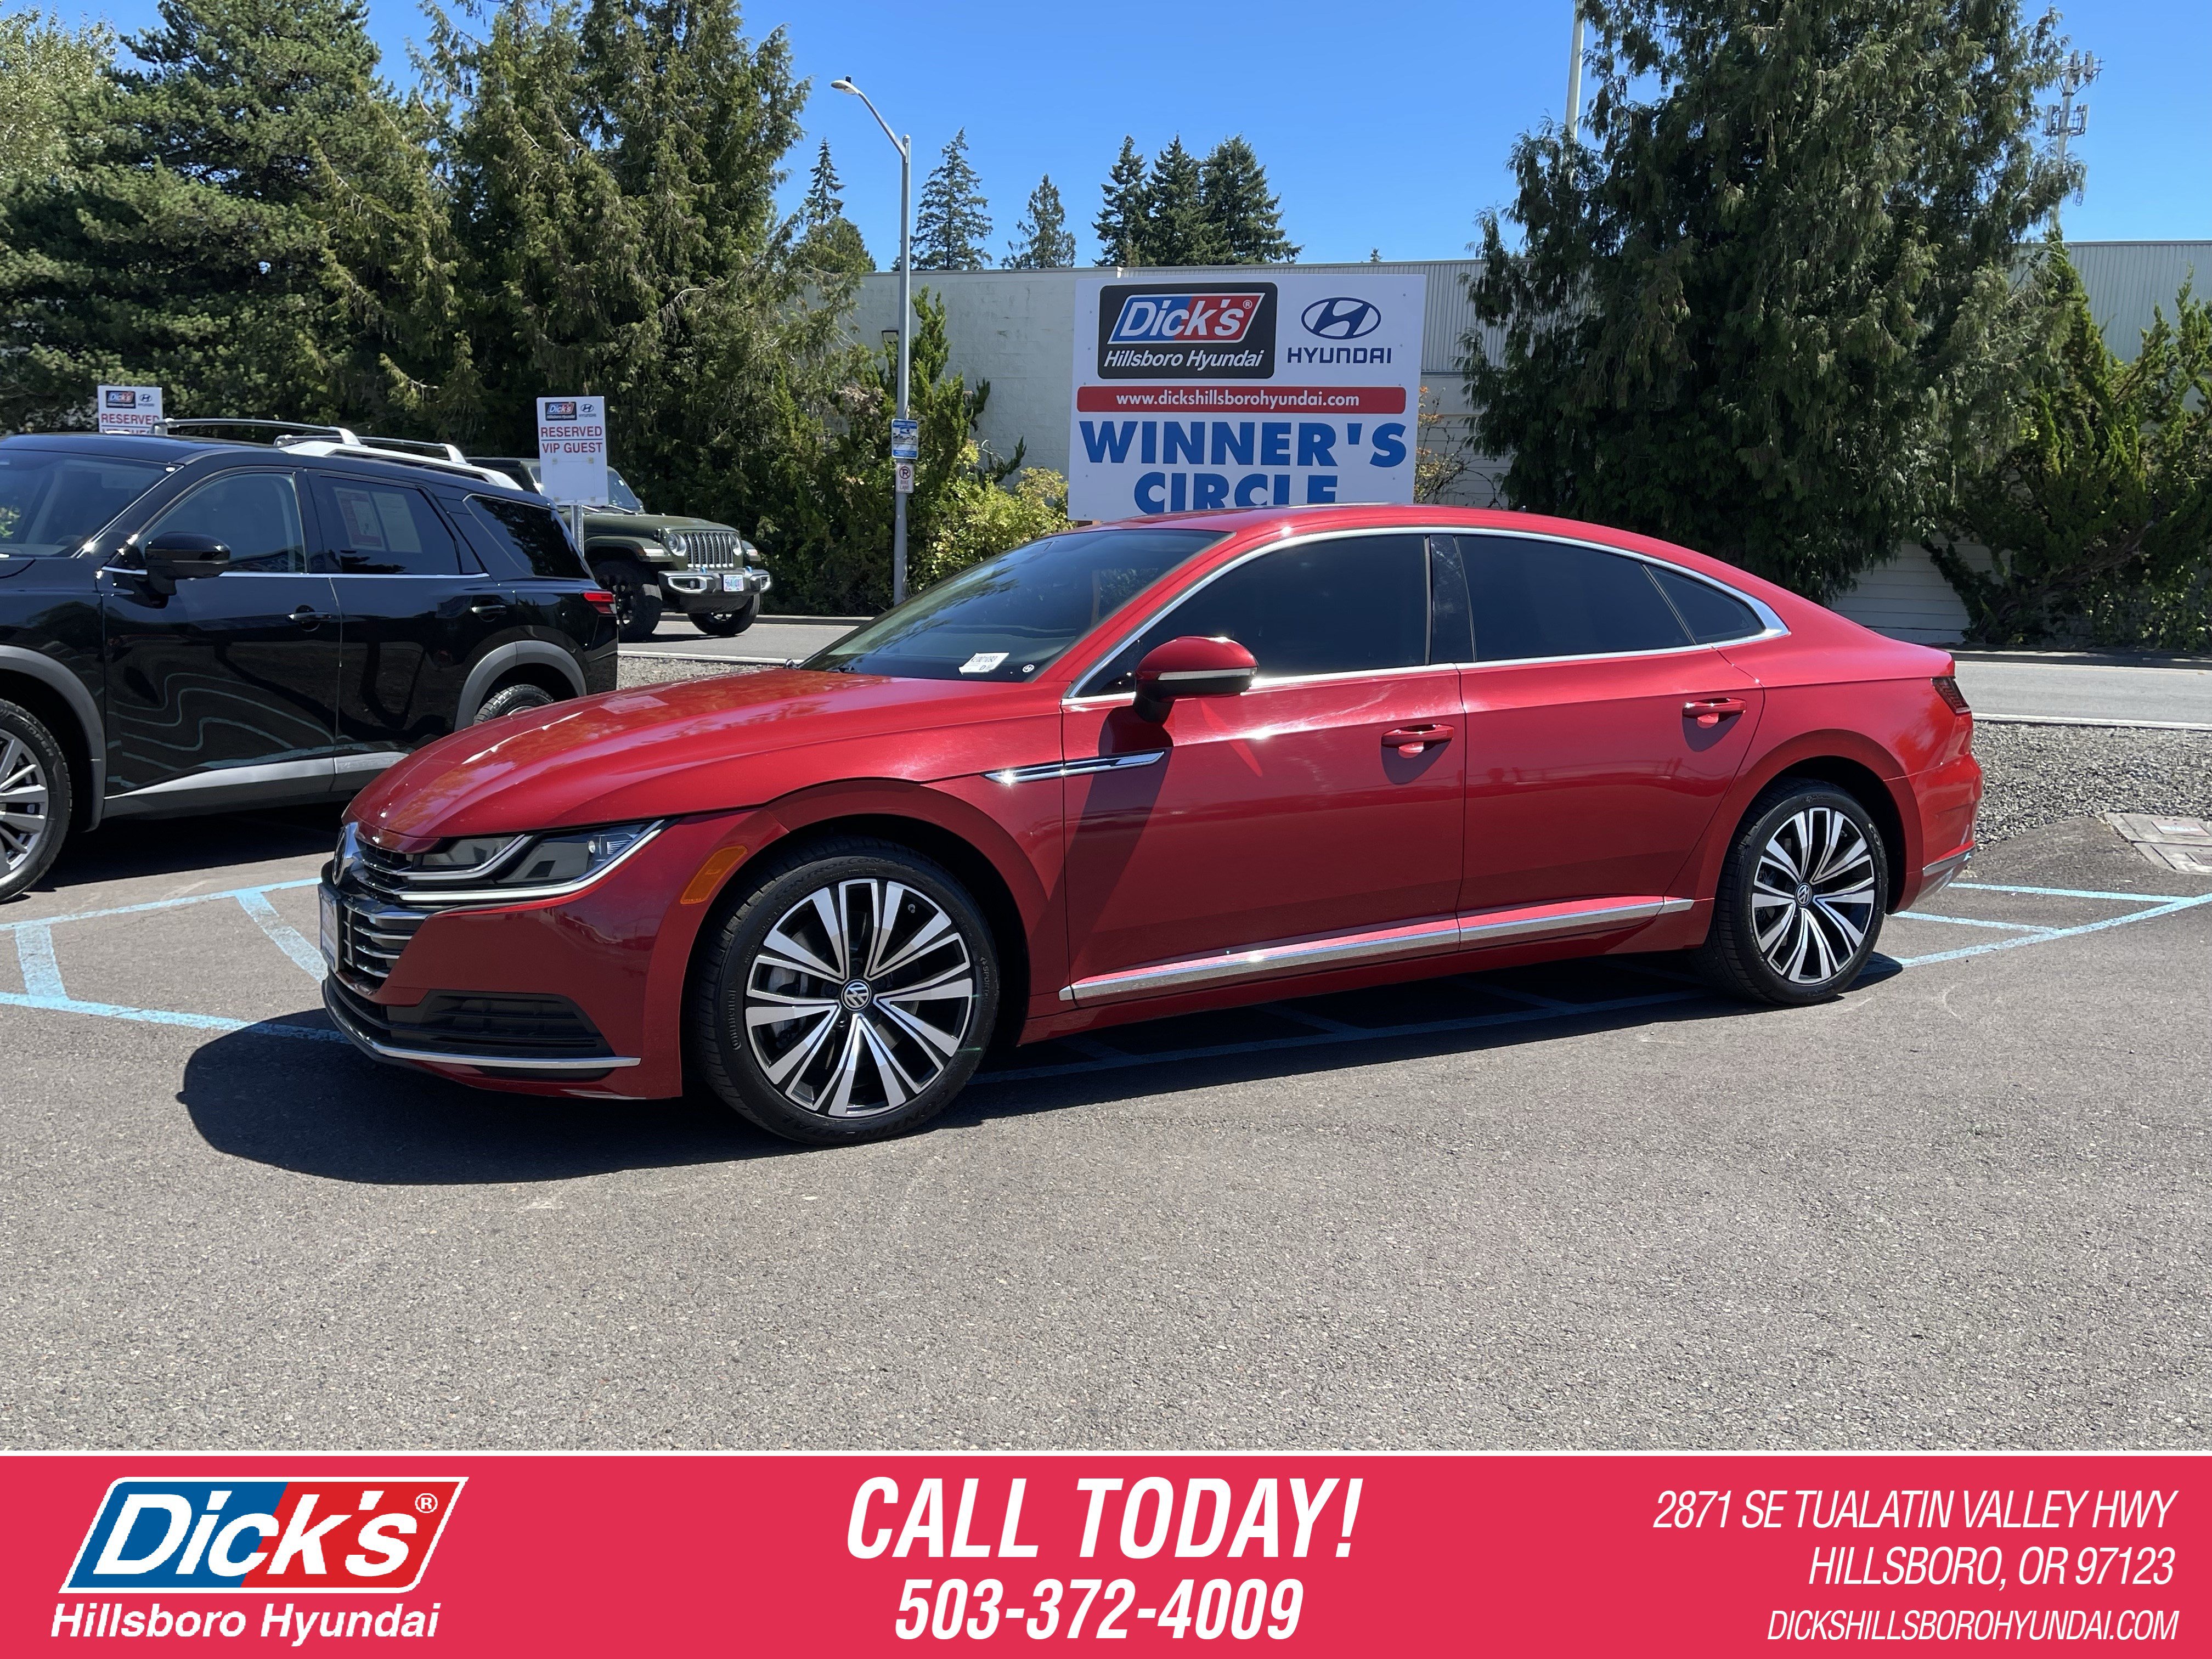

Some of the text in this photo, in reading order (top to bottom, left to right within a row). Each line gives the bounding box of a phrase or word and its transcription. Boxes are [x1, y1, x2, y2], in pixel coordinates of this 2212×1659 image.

[1119, 298, 1244, 337] Dick's
[1104, 350, 1264, 371] Hillsboro Hyundai
[1288, 348, 1391, 364] HYUNDAI
[1116, 390, 1359, 410] www.dickshillsborohyundai.com
[541, 426, 602, 437] RESERVED
[542, 442, 603, 453] VIP GUEST
[1079, 421, 1407, 468] WINNER'S
